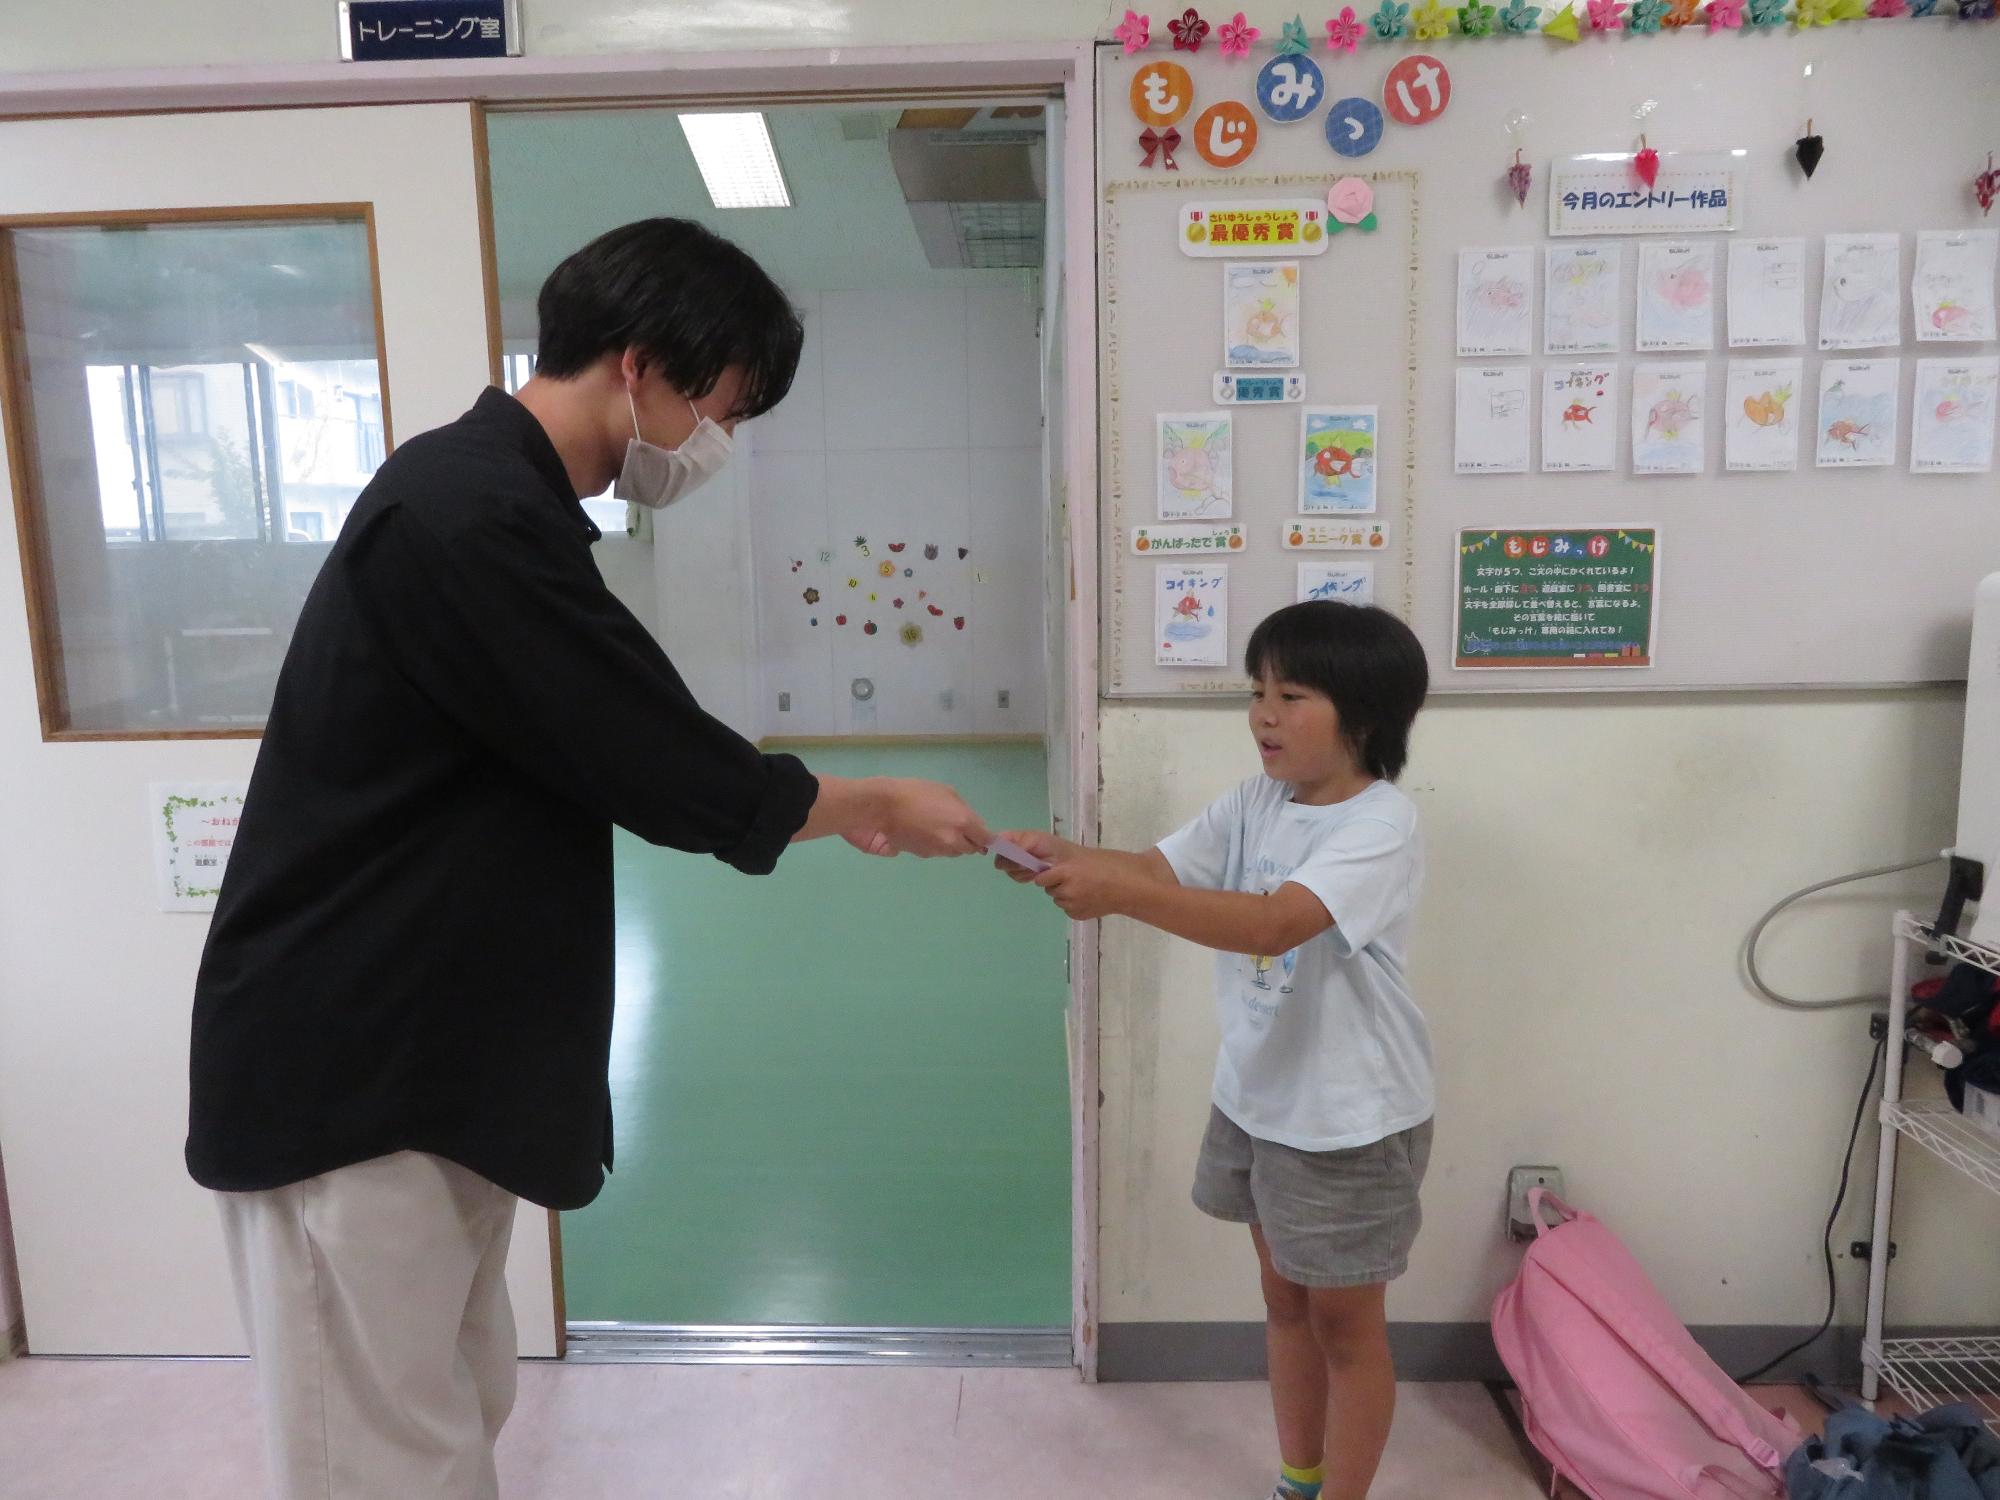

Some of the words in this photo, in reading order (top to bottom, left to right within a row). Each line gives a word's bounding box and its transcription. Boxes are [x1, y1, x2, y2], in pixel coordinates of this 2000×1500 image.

[359, 16, 501, 42] トレーニング室
[1142, 62, 1442, 158] もじみっけ
[1562, 189, 1727, 210] 今月のエントリー作品
[1211, 223, 1295, 242] 最優秀賞
[1508, 537, 1608, 556] もじみっけ
